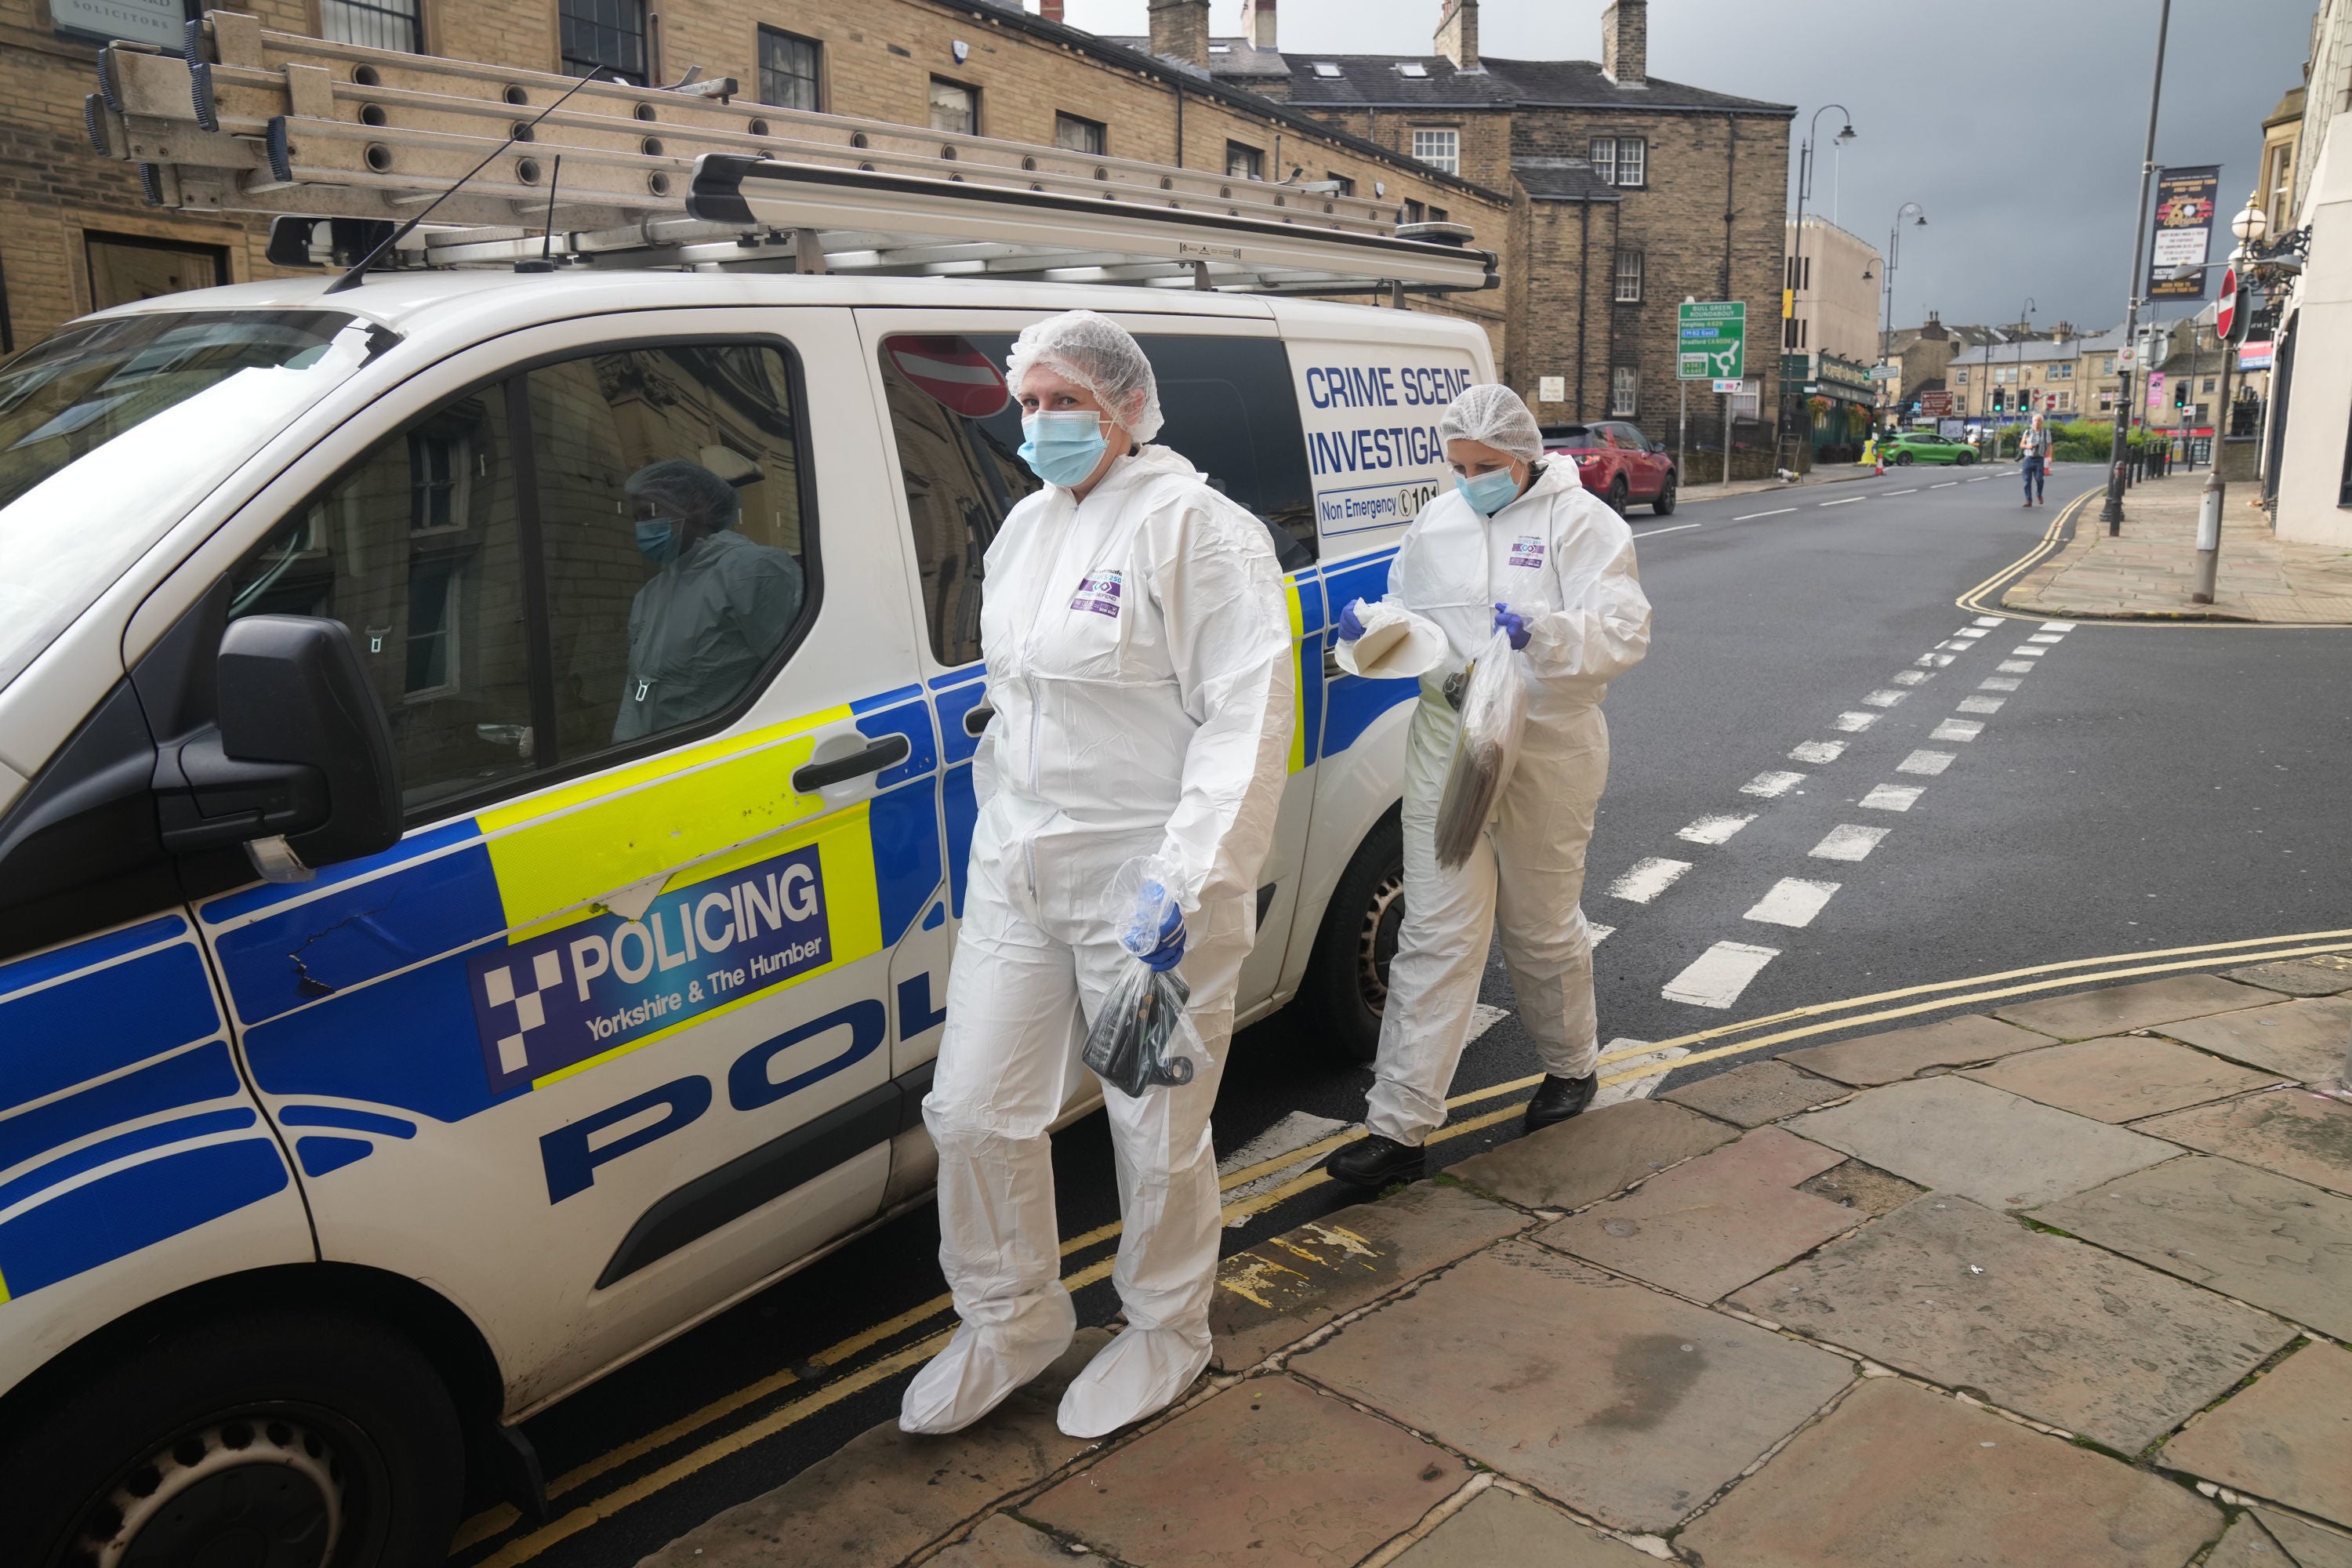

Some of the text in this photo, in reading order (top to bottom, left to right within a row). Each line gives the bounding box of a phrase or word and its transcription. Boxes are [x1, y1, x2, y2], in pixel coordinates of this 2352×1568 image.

[73, 1, 168, 30] SOLICITORS
[1306, 367, 1472, 408] CRIME SCENE
[1308, 426, 1445, 475] INVESTIGA
[1322, 501, 1343, 521] Non
[1345, 496, 1396, 519] Emergency
[1109, 575, 1122, 583] 250
[569, 863, 818, 1002] POLICING
[586, 936, 822, 1041] Yorkshire & The Humber
